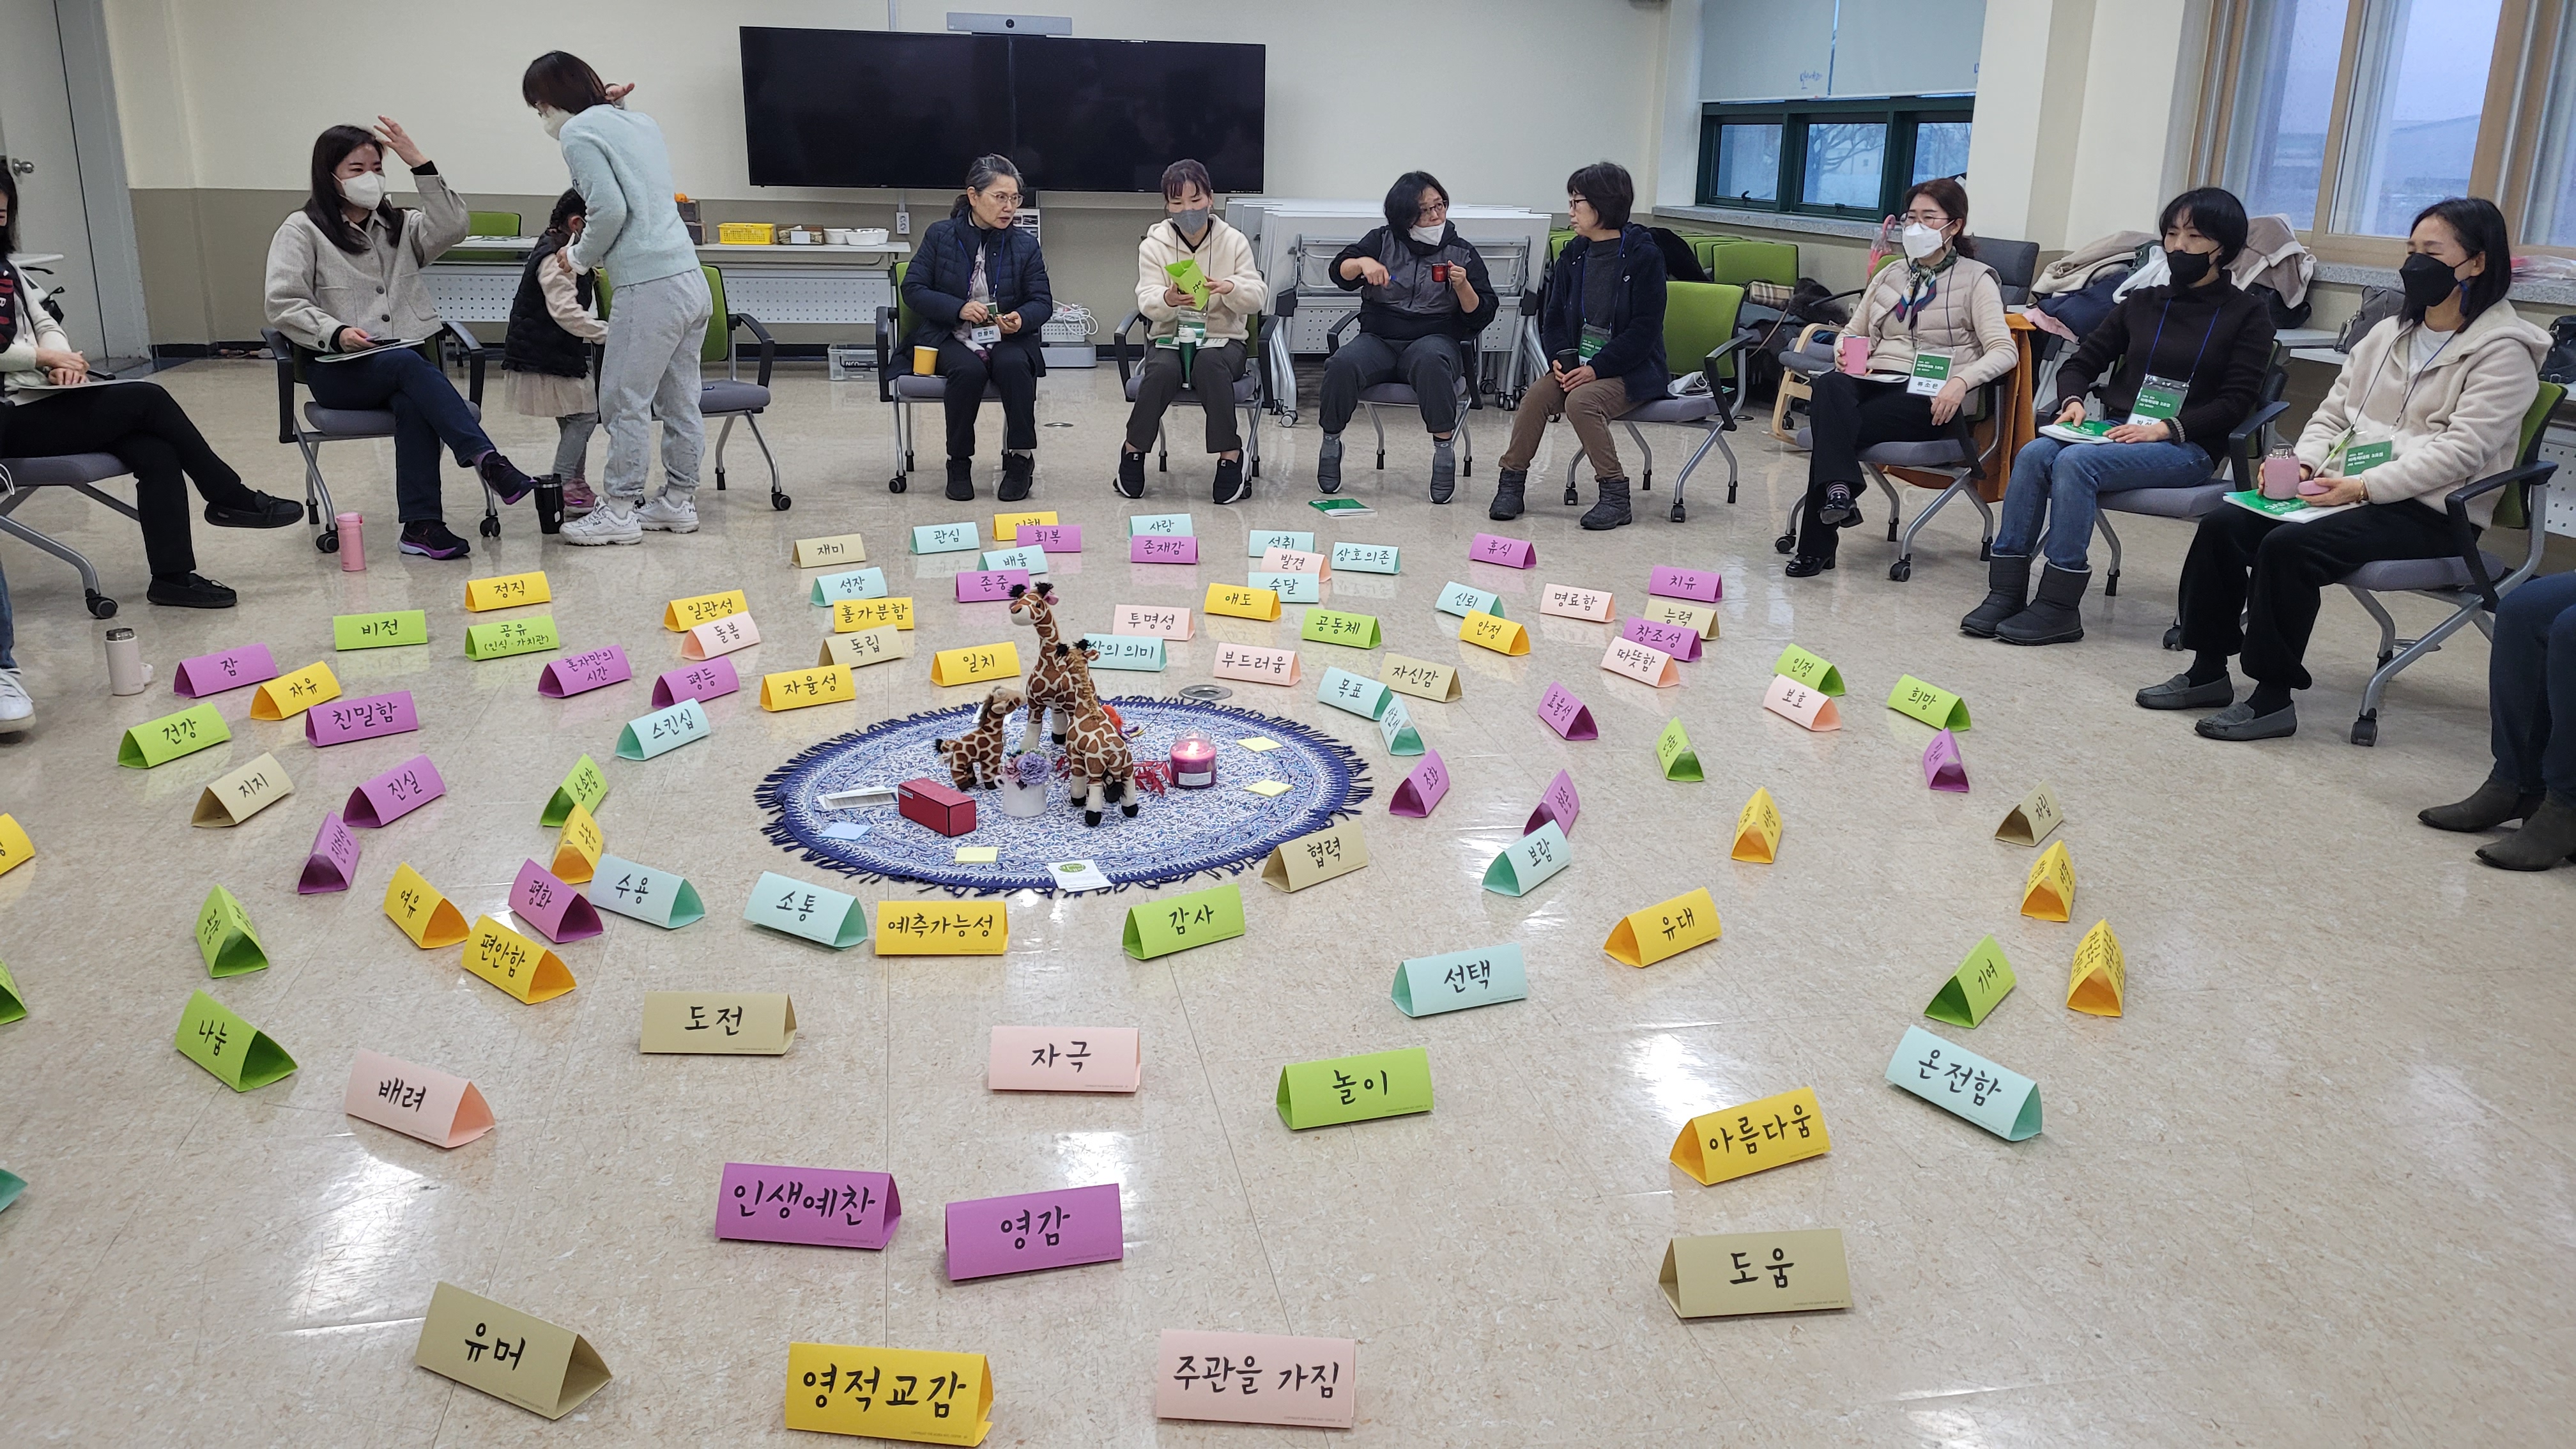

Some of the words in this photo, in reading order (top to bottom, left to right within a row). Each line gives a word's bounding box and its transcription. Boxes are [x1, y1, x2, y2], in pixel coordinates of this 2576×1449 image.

[933, 528, 960, 544] 관심
[1035, 529, 1061, 545] 회복
[1149, 519, 1175, 533] 사랑
[816, 543, 844, 556] 재미
[1144, 540, 1184, 555] 존재감
[1268, 536, 1294, 548] 성취
[1487, 539, 1512, 557] 휴식
[1002, 553, 1027, 567] 배움
[1280, 554, 1305, 571] 발견
[1336, 548, 1390, 565] 상호의존
[493, 579, 525, 599] 정직
[839, 576, 865, 594] 성장
[981, 574, 1009, 592] 존중
[1669, 575, 1697, 590] 치유
[687, 597, 733, 620] 일관성
[1225, 592, 1252, 606] 애도
[1455, 592, 1478, 609] 신뢰
[1554, 592, 1598, 611] 명료함
[841, 603, 908, 624] 홀가분함
[1128, 612, 1175, 631] 투명성
[1315, 615, 1361, 635] 공동체
[1664, 608, 1693, 627] 능력
[361, 618, 398, 636] 비전
[500, 624, 527, 638] 공유
[714, 622, 740, 644] 돌봄
[1476, 620, 1502, 640] 안정
[1636, 624, 1682, 648] 창조성
[850, 634, 880, 657] 독립
[1124, 644, 1154, 659] 의미
[220, 657, 238, 677] 잠
[565, 649, 614, 671] 혼자만의
[963, 653, 995, 673] 일치
[1222, 651, 1286, 674] 부드러움
[1616, 648, 1656, 672] 따뜻함
[1791, 658, 1814, 678] 인정
[587, 666, 608, 681] 시간
[686, 668, 716, 691] 평등
[783, 673, 836, 696] 자율성
[1392, 665, 1439, 688] 자신감
[289, 678, 318, 698] 자유
[1338, 678, 1363, 698] 목표
[1781, 688, 1806, 709] 보호
[1908, 687, 1936, 710] 희망
[332, 702, 397, 730] 친밀함
[1547, 691, 1573, 721] 효율성
[162, 717, 197, 745] 건강
[653, 709, 694, 739] 스킨십
[238, 772, 269, 798] 지지
[387, 770, 423, 801] 진실
[574, 767, 598, 802] 소속감
[1423, 766, 1439, 791] 조화
[1555, 786, 1572, 815] 현존
[2035, 793, 2051, 821] 자립
[1307, 836, 1340, 869] 협력
[1528, 838, 1552, 867] 보람
[529, 880, 552, 910] 평화
[615, 873, 649, 905] 수용
[401, 889, 419, 919] 여유
[776, 891, 816, 922] 소통
[888, 912, 993, 939] 예측가능성
[1169, 904, 1215, 935] 감사
[1662, 907, 1695, 942] 유대
[480, 933, 526, 978] 편안함
[1444, 960, 1490, 993] 선택
[1978, 958, 1998, 994] 기여
[684, 1006, 743, 1036] 도전
[199, 1020, 227, 1057] 나눔
[1031, 1041, 1092, 1073] 자극
[1332, 1070, 1388, 1105] 놀이
[1917, 1049, 2002, 1107] 온전함
[378, 1077, 427, 1112] 배려
[1709, 1104, 1811, 1155] 아름다움
[734, 1180, 876, 1226] 인생예찬
[1000, 1205, 1071, 1250] 영감
[1729, 1248, 1795, 1289] 도움
[464, 1322, 526, 1371] 유머
[1173, 1355, 1263, 1395] 주관을
[1277, 1361, 1339, 1399] 가짐
[803, 1363, 967, 1418] 영적교감
